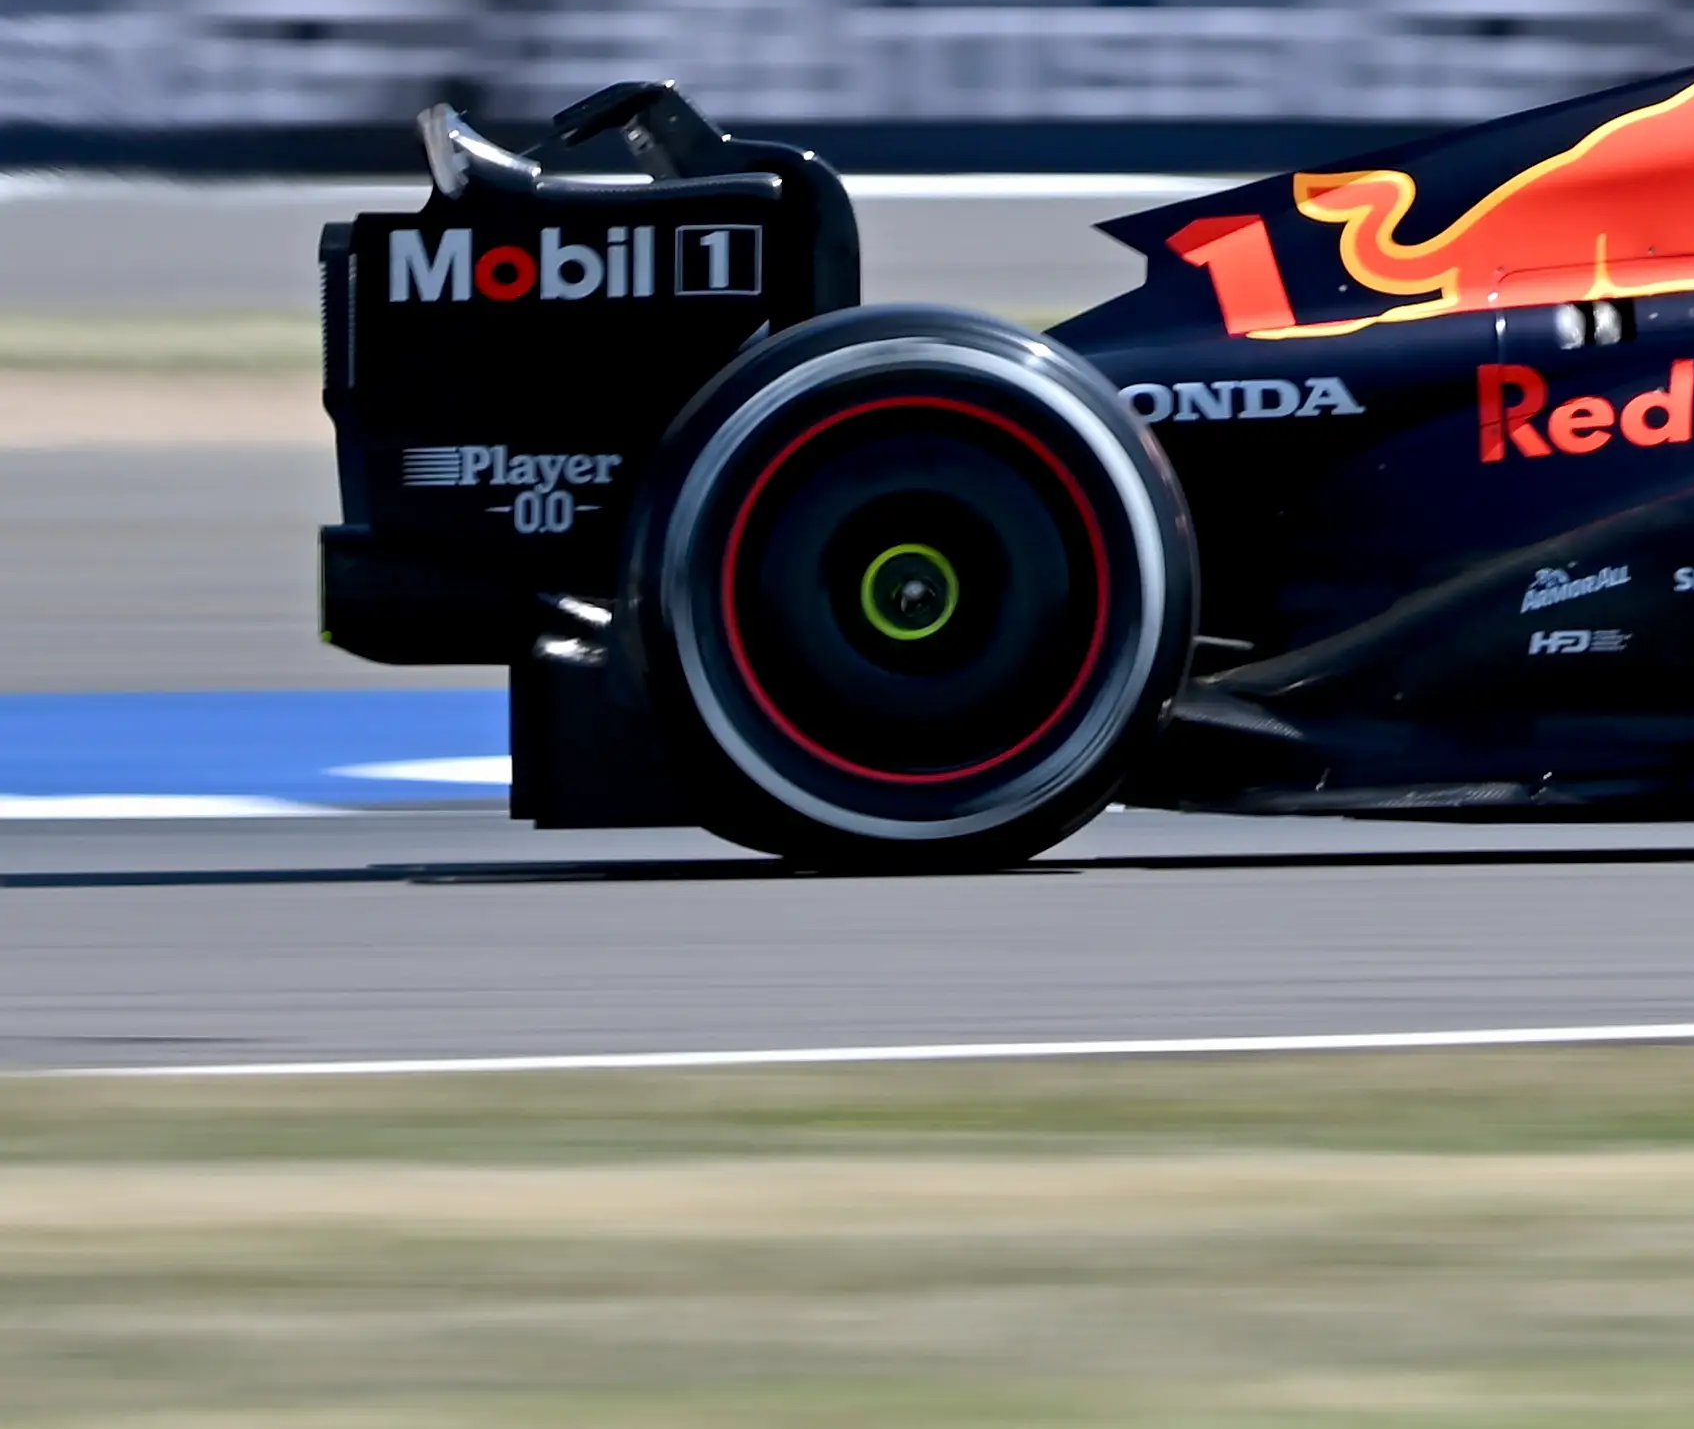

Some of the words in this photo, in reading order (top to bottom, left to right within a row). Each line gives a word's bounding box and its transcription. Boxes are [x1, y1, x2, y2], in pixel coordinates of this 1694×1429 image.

[389, 226, 655, 302] Mobil
[700, 231, 731, 288] 1
[1165, 214, 1296, 337] 1
[1117, 376, 1367, 424] ONDA
[1476, 359, 1694, 462] Red
[458, 445, 623, 494] Player
